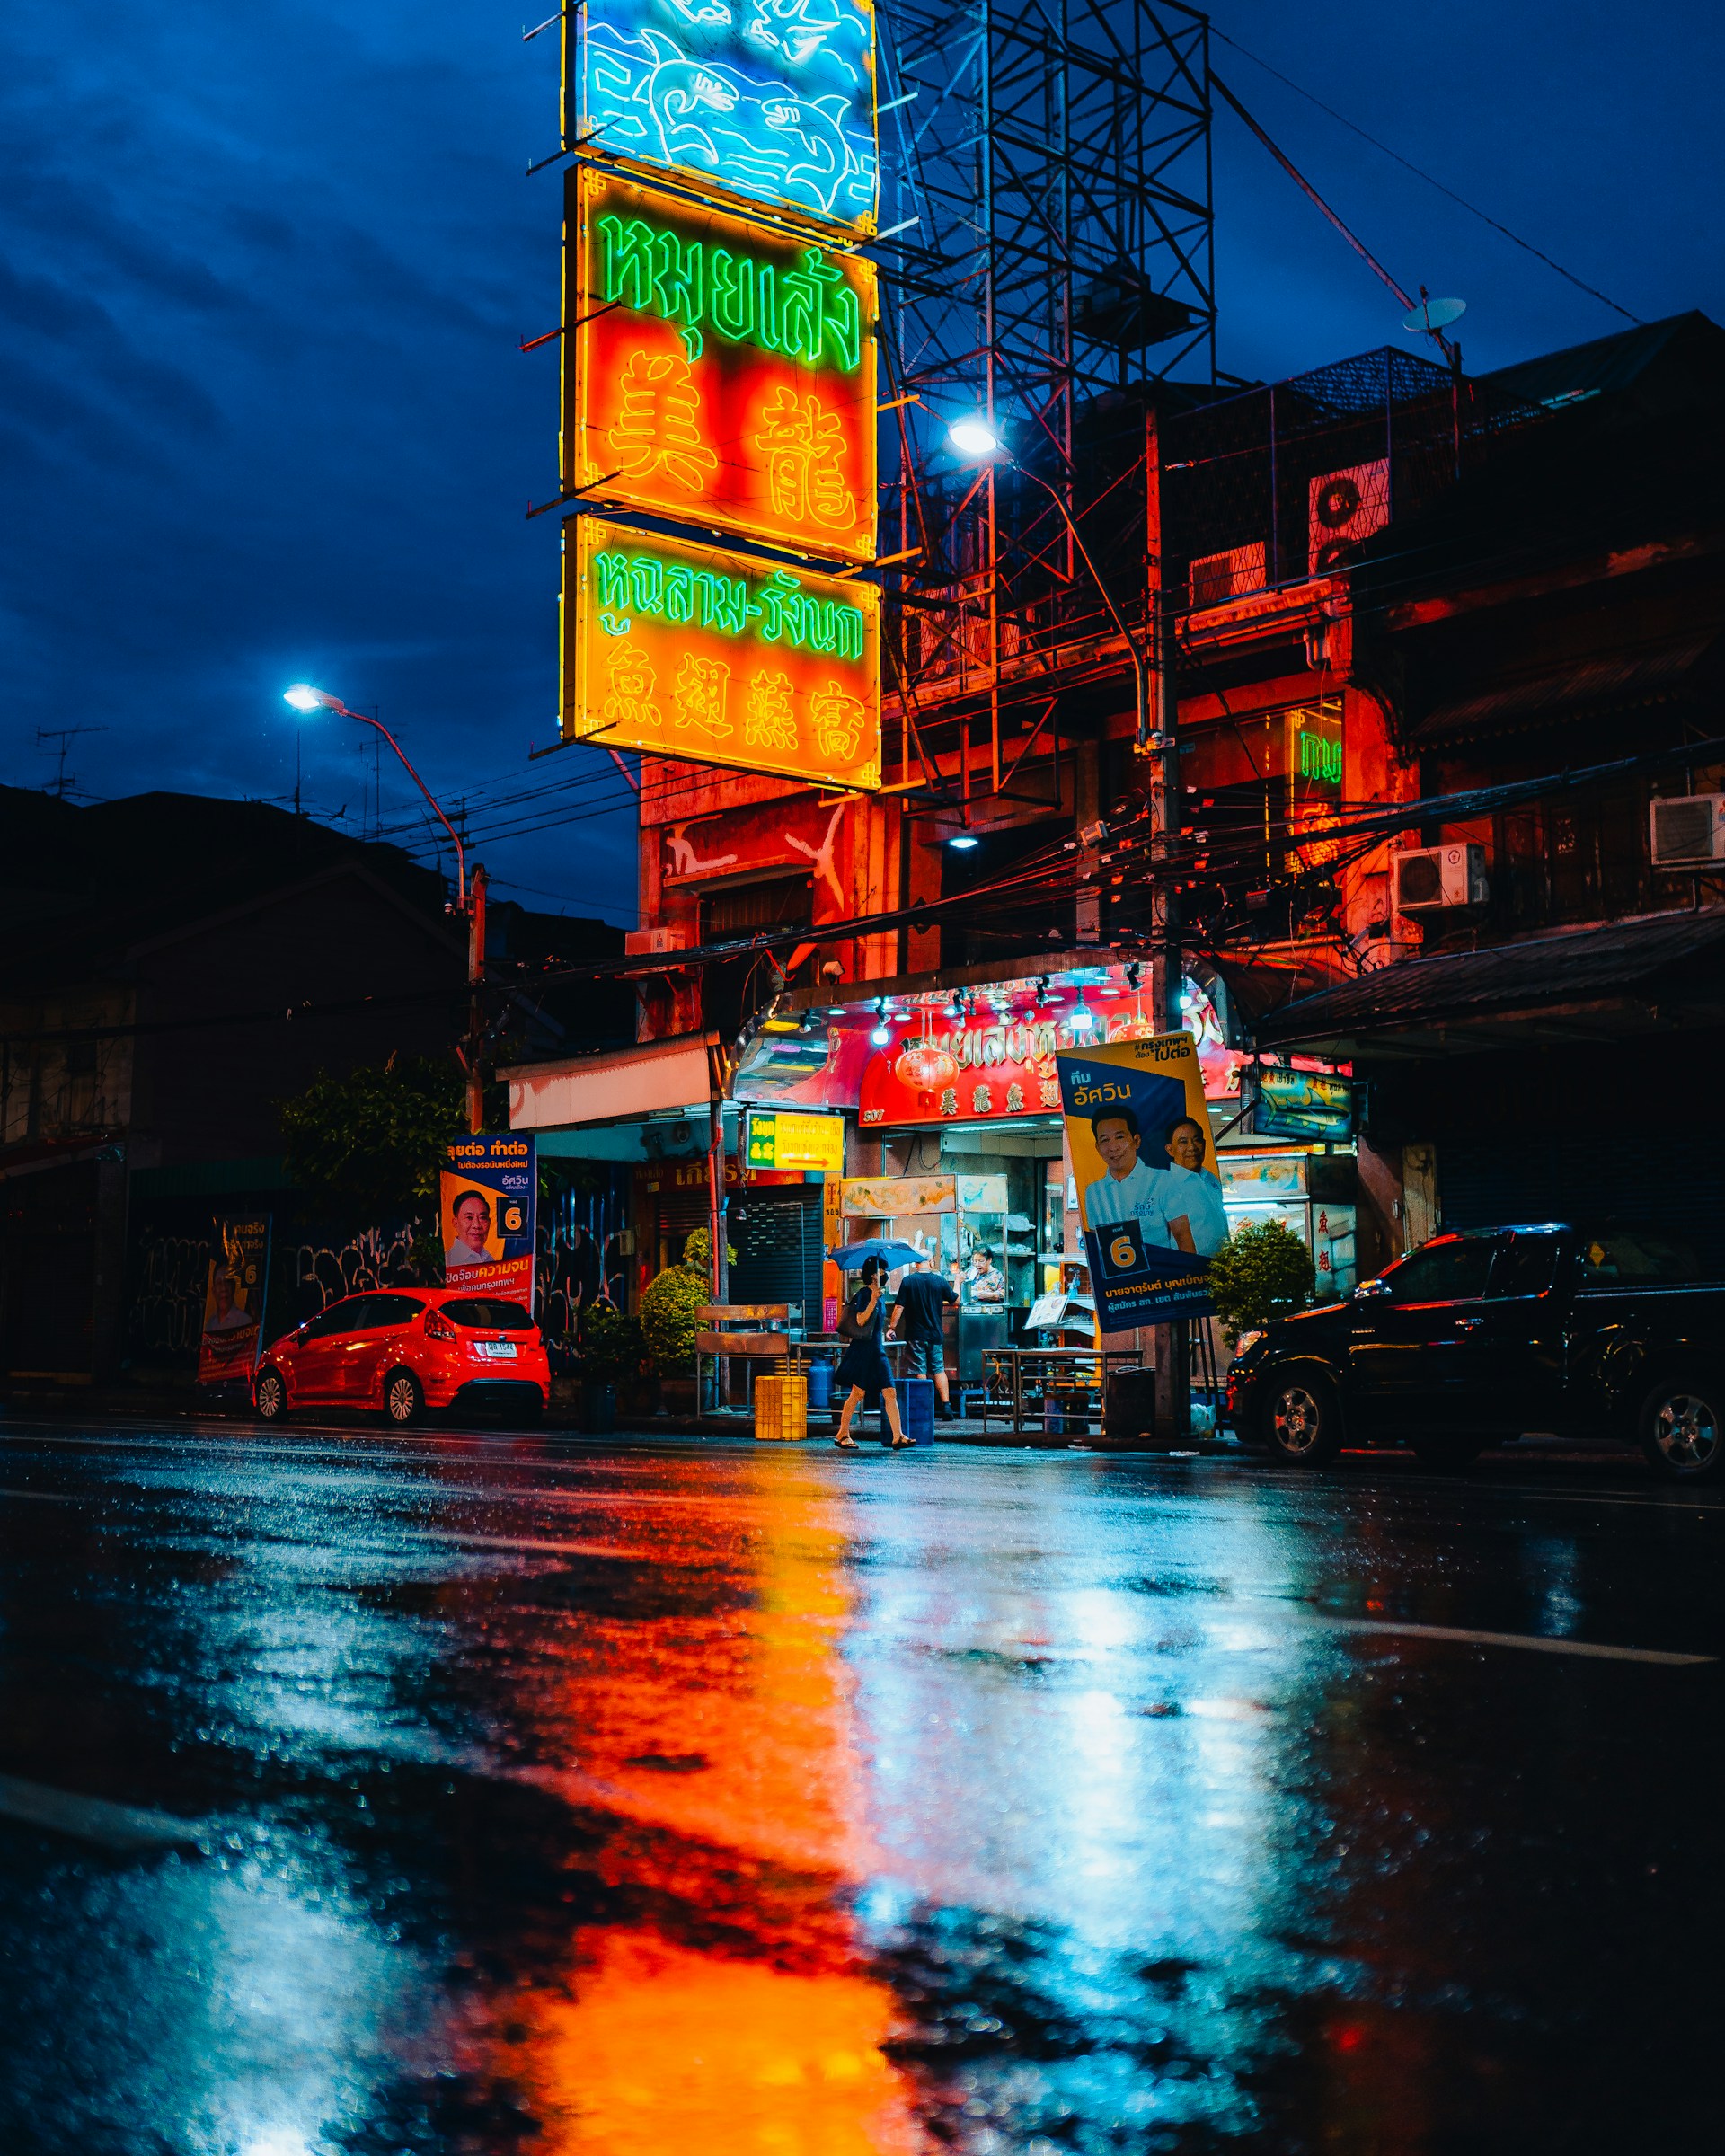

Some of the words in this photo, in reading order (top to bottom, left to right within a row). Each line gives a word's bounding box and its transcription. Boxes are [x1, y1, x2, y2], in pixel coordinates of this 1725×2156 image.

[609, 351, 855, 529] 美龍
[1071, 1070, 1091, 1085] ทีม
[1075, 1082, 1131, 1106] อัศวิน
[863, 1109, 885, 1122] 507
[490, 1140, 528, 1156] ทำต่อ
[502, 1175, 528, 1185] อัศวิน
[505, 1207, 521, 1231] 6
[1110, 1235, 1136, 1268] 6
[245, 1264, 258, 1285] 6
[1155, 1295, 1172, 1304] เขต
